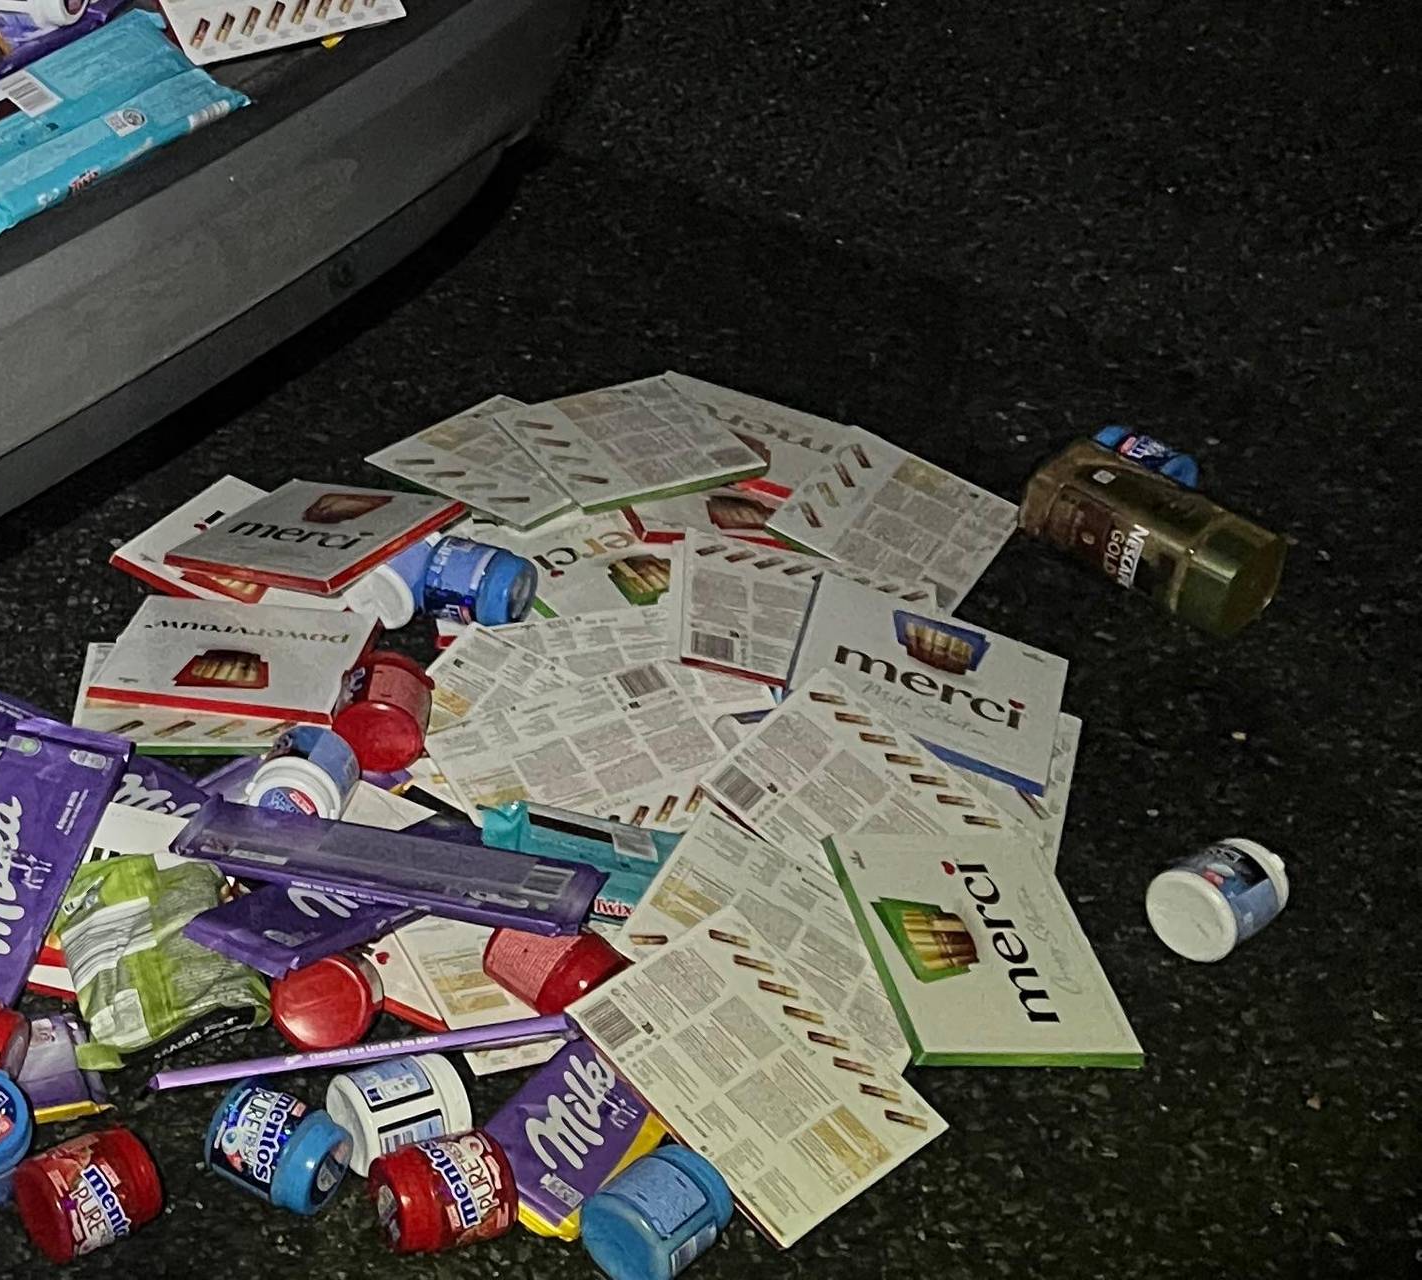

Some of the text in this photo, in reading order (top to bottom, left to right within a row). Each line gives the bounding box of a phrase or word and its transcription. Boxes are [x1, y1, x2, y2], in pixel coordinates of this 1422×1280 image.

[228, 520, 375, 550] merci
[532, 530, 638, 579] erci
[834, 644, 1026, 730] merci
[940, 860, 1061, 1023] merci
[254, 1093, 296, 1182] mentos
[71, 1185, 107, 1235] PURE
